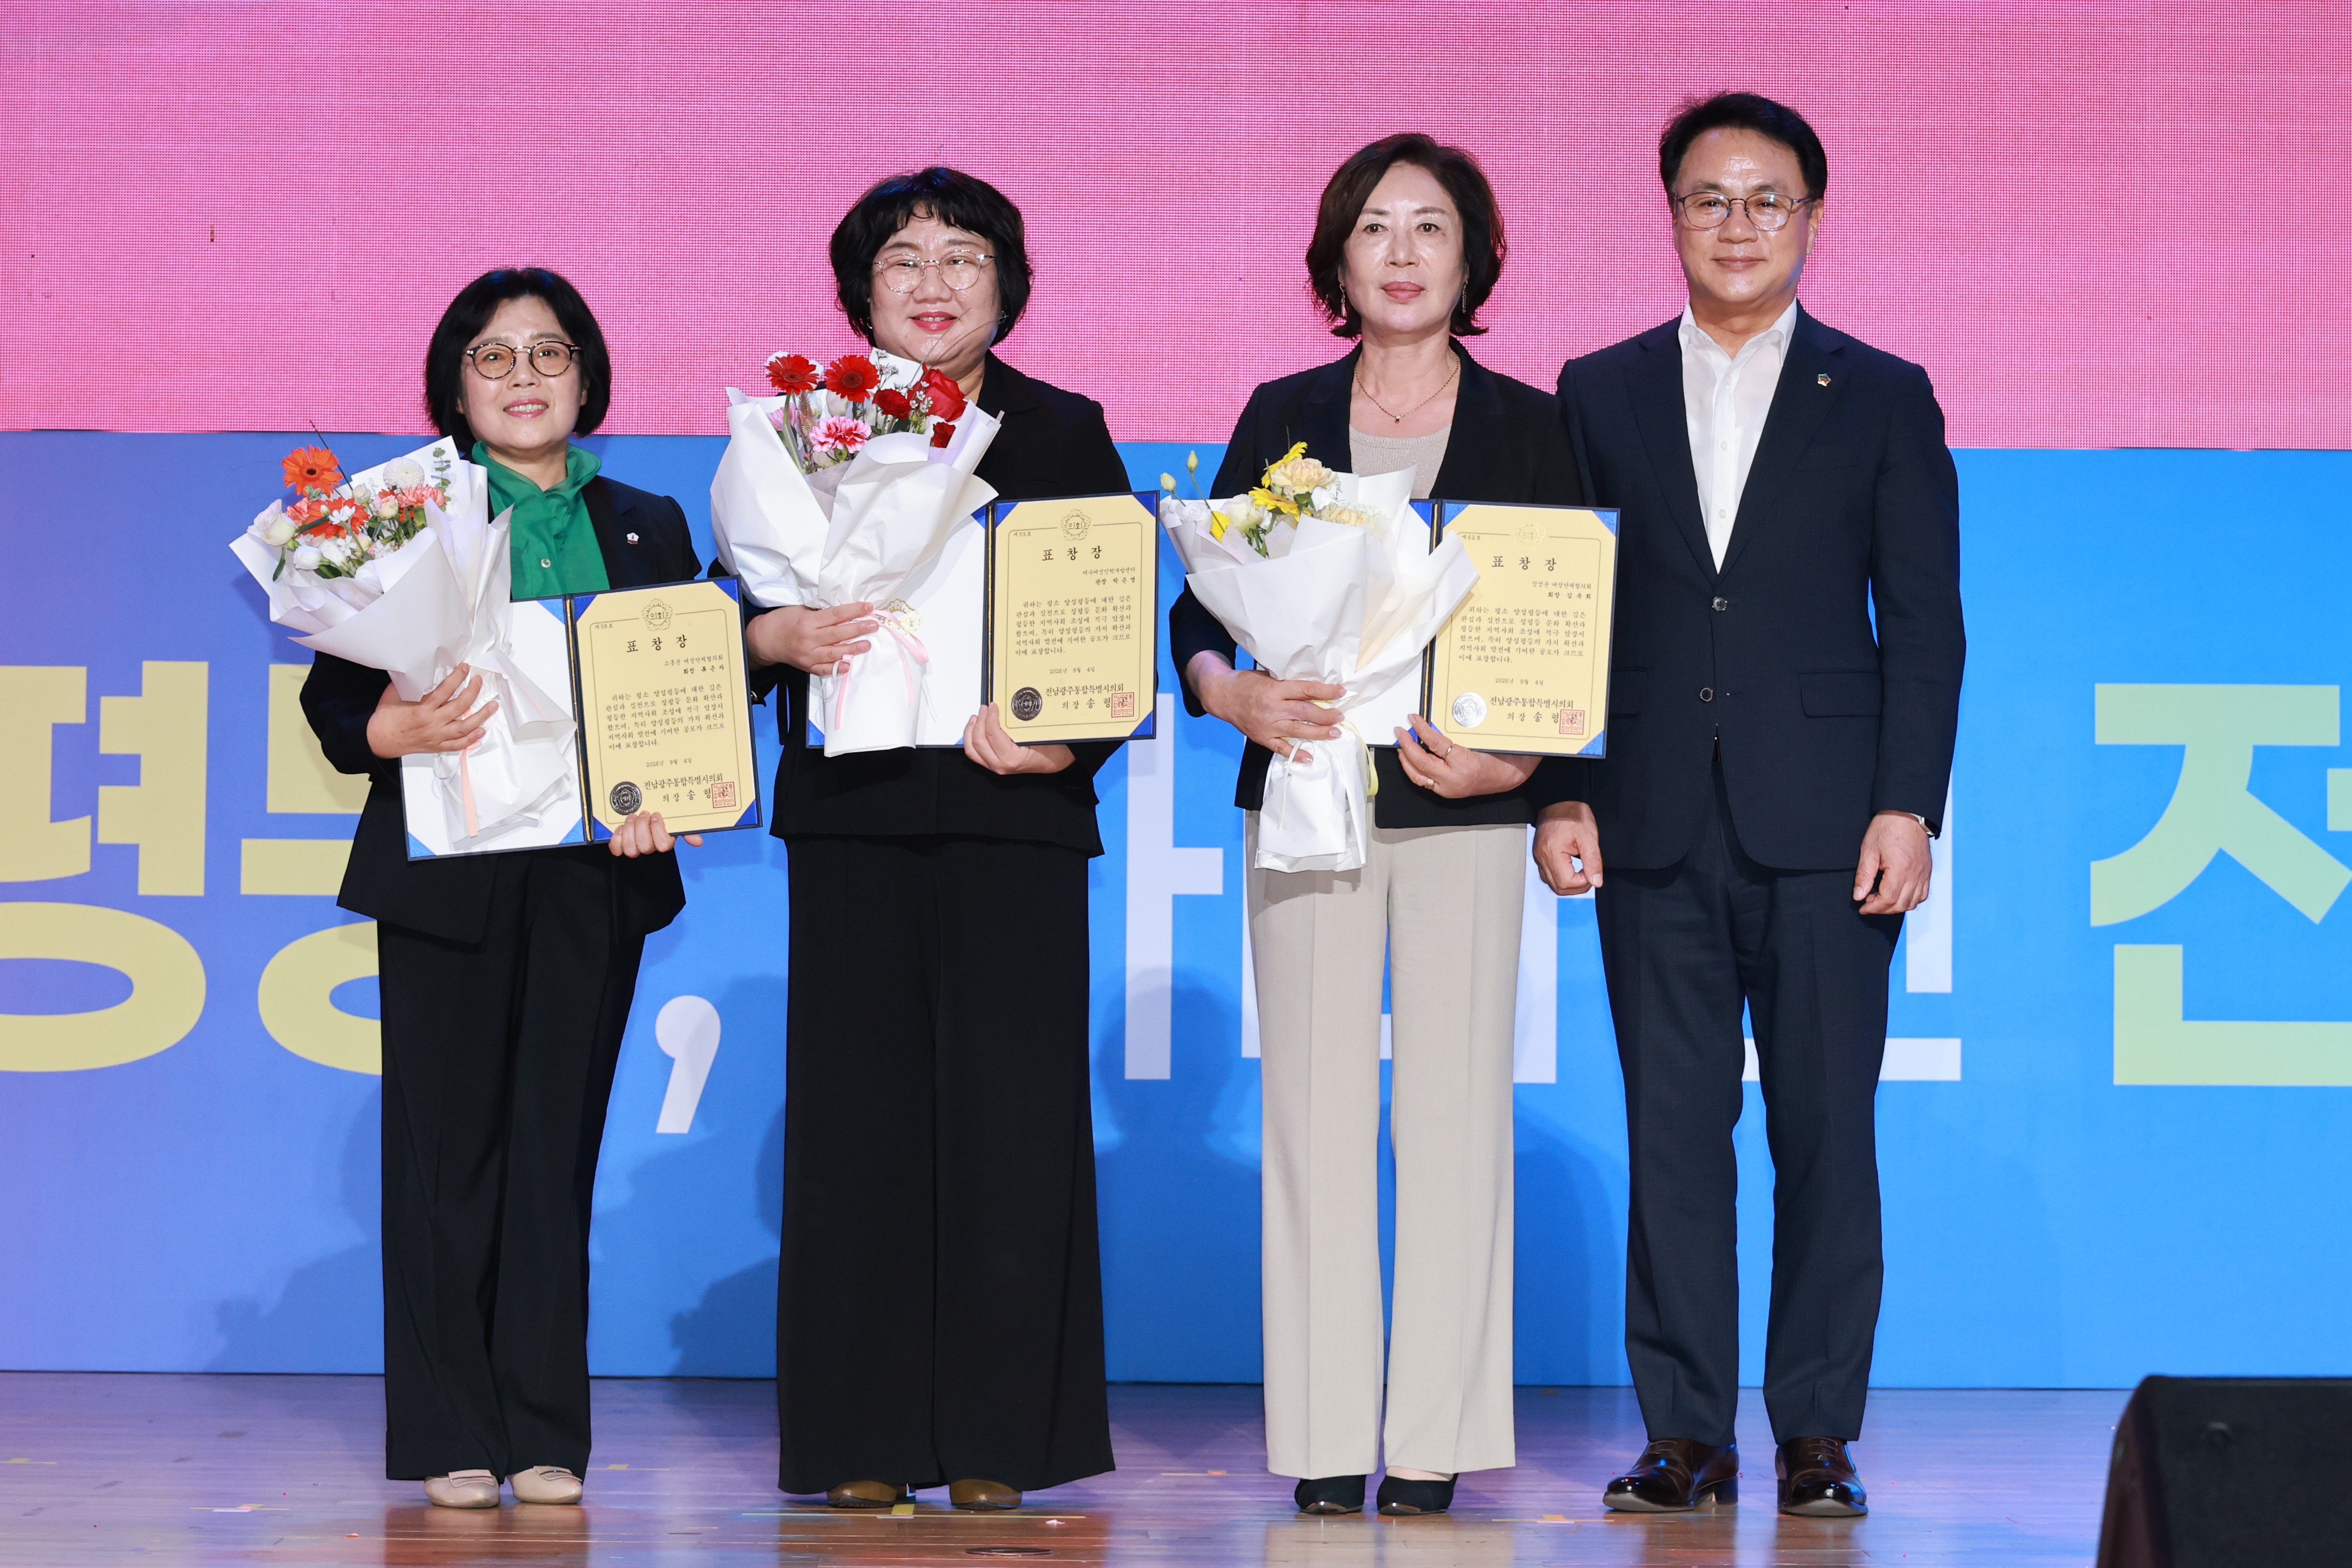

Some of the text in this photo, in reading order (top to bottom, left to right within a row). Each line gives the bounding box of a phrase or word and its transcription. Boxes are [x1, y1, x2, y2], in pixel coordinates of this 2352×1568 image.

[1067, 522, 1082, 530] 의회
[1064, 597, 1096, 606] 양성평등에
[650, 611, 665, 620] 의회
[1016, 610, 1036, 618] 관심과
[1071, 607, 1090, 615] 성평등
[1111, 604, 1132, 612] 확산과
[1513, 608, 1548, 617] 양성평등에
[1016, 620, 1035, 628] 평등한
[1040, 618, 1065, 626] 지역사회
[1058, 626, 1091, 635] 양성평등의
[1111, 623, 1131, 632] 확산과
[1486, 626, 1514, 635] 지역사회
[1016, 638, 1040, 647] 지역사회
[1089, 634, 1109, 643] 공로가
[1506, 637, 1541, 646] 양성평등의
[1459, 644, 1486, 653] 지역사회
[653, 687, 686, 697] 양성평등에
[1045, 683, 1123, 697] 전남광주통합특별시의회
[606, 703, 626, 712] 관심과
[661, 697, 681, 706] 성평등
[685, 695, 698, 704] 문화
[703, 693, 723, 702] 확산과
[1490, 696, 1573, 710] 전남광주통합특별시의회
[606, 713, 626, 722] 평등한
[631, 709, 657, 719] 지역사회
[661, 707, 681, 715] 조성에
[704, 702, 723, 712] 앞장서
[651, 717, 683, 727] 양성평등의
[705, 712, 724, 721] 확산과
[608, 731, 634, 741] 지역사회
[683, 724, 703, 733] 공로가
[644, 773, 723, 790] 전남광주통합특별시의회
